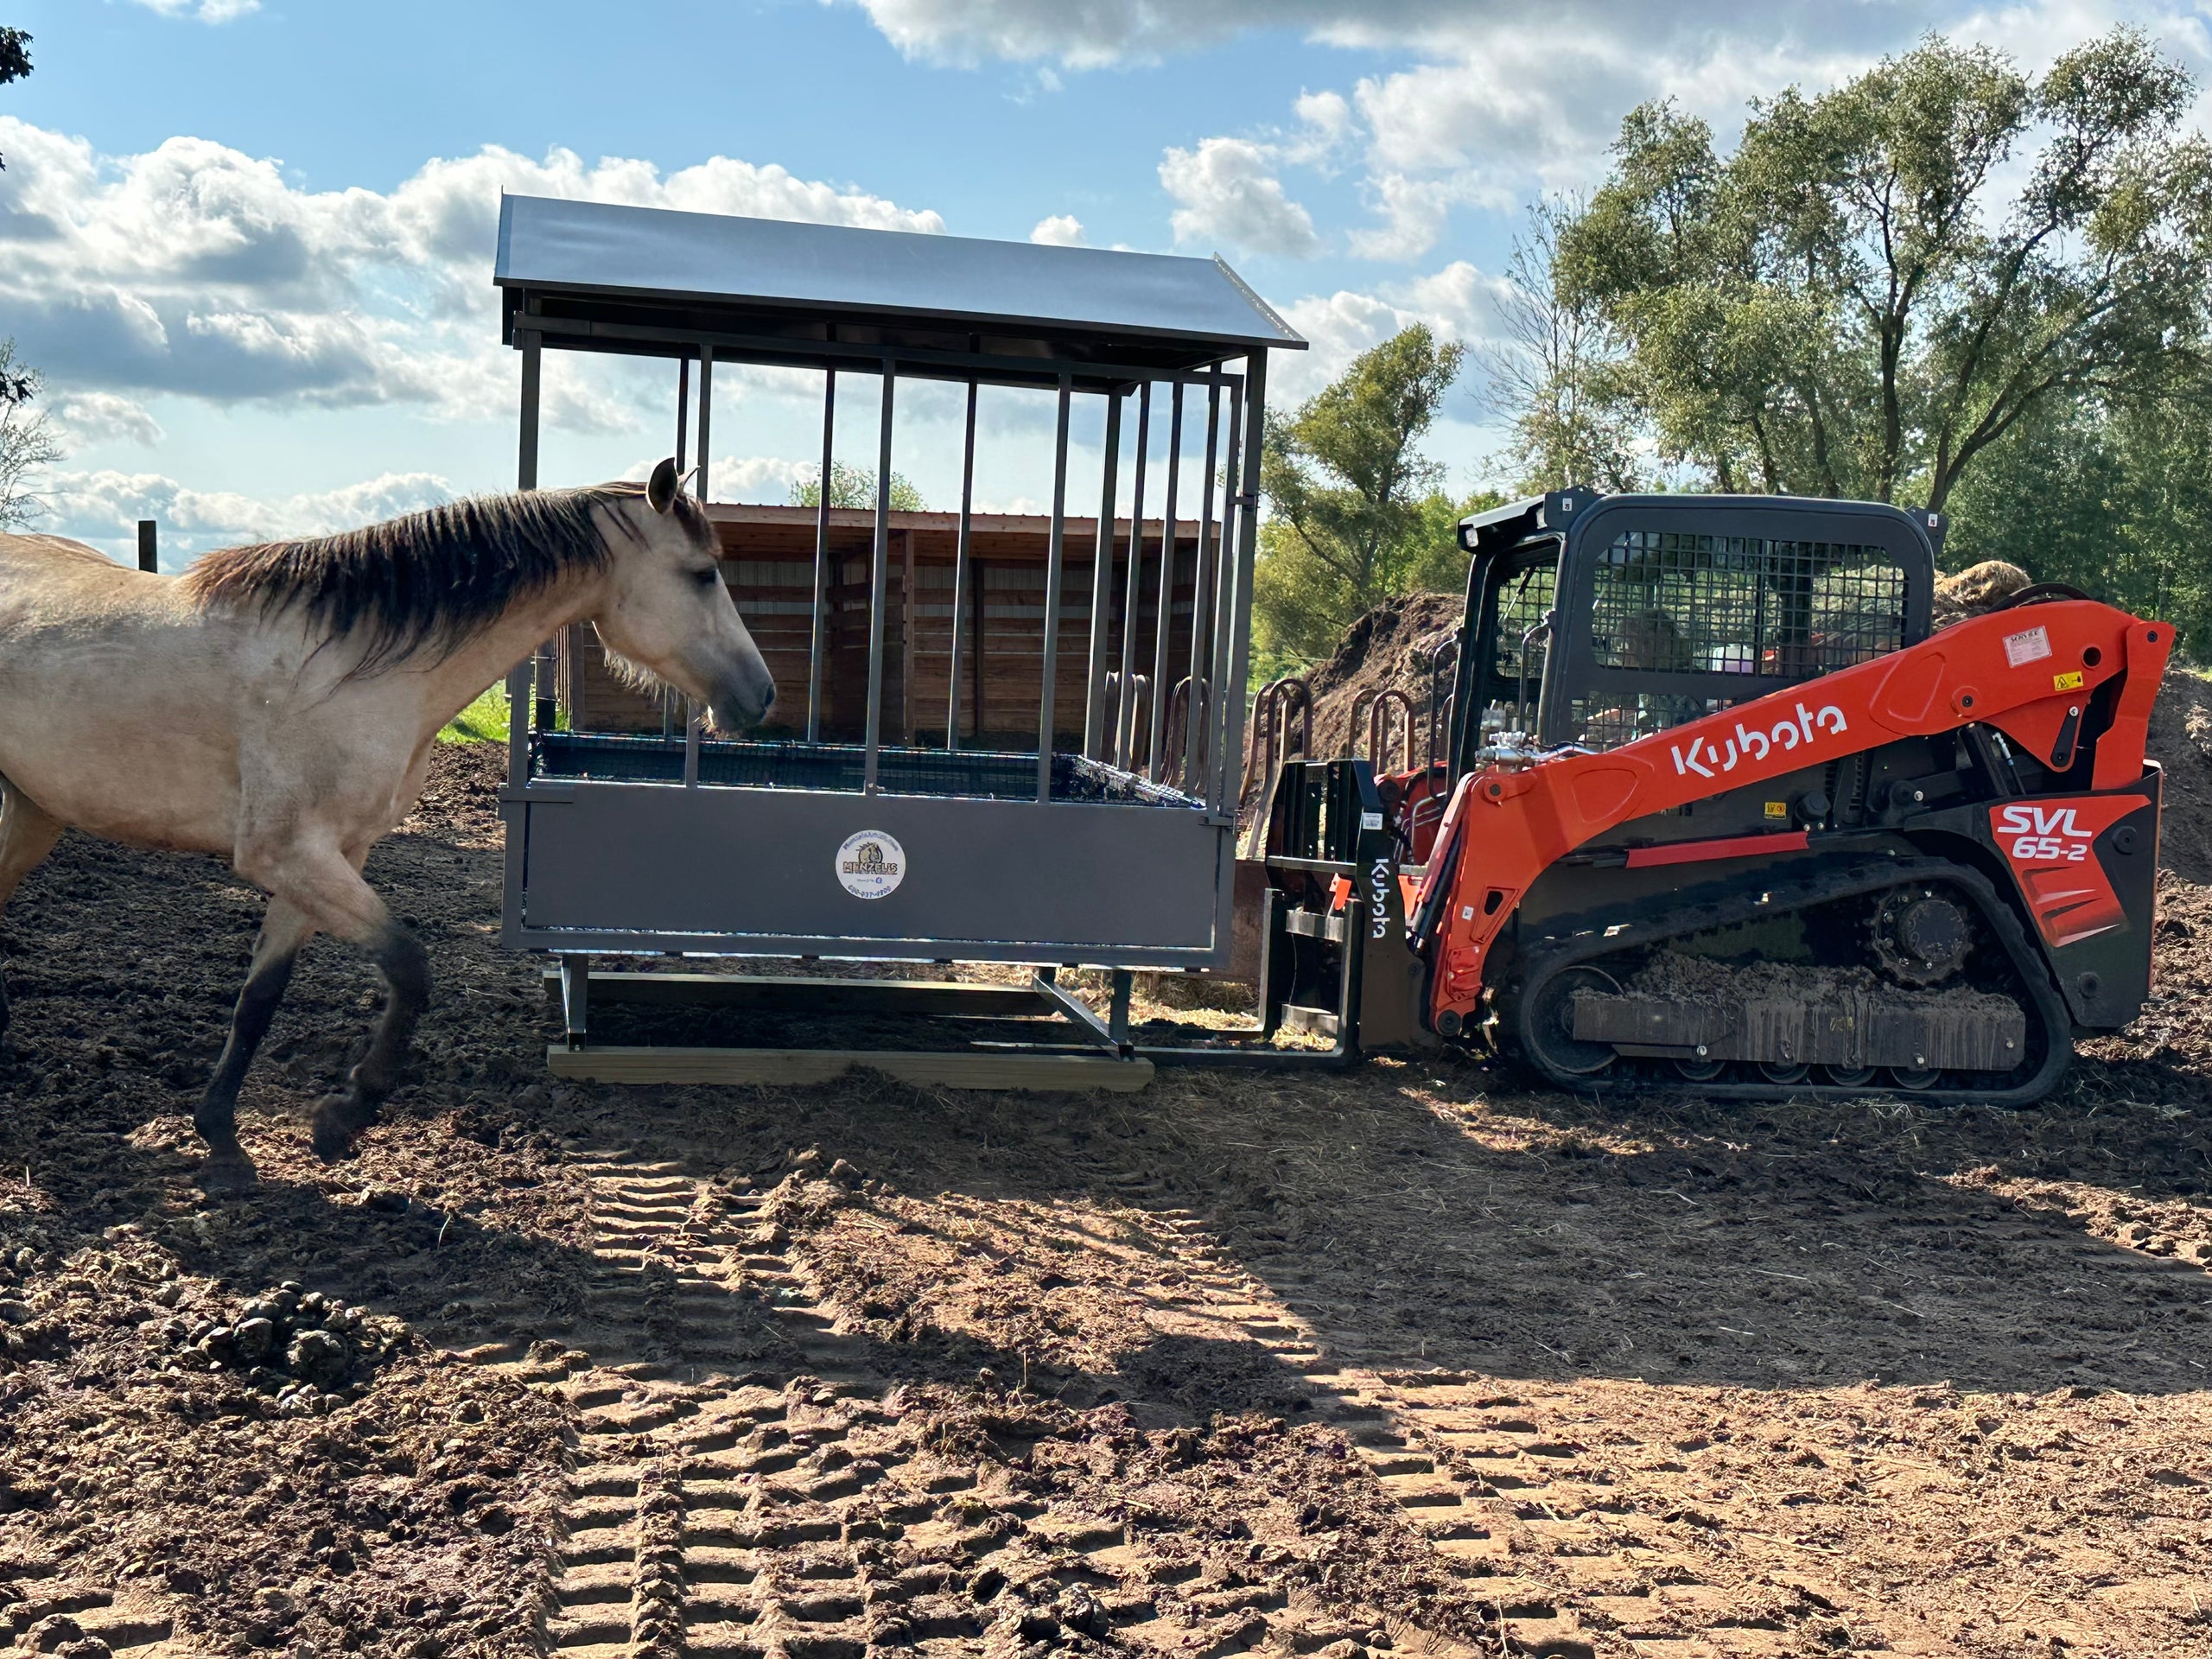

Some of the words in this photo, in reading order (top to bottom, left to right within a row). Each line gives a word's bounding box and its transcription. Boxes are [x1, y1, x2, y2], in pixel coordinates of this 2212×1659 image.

[1671, 702, 1847, 778] Kubota
[1998, 806, 2093, 837] SVL
[2012, 836, 2088, 861] 65-2
[1371, 858, 1391, 939] Kubota
